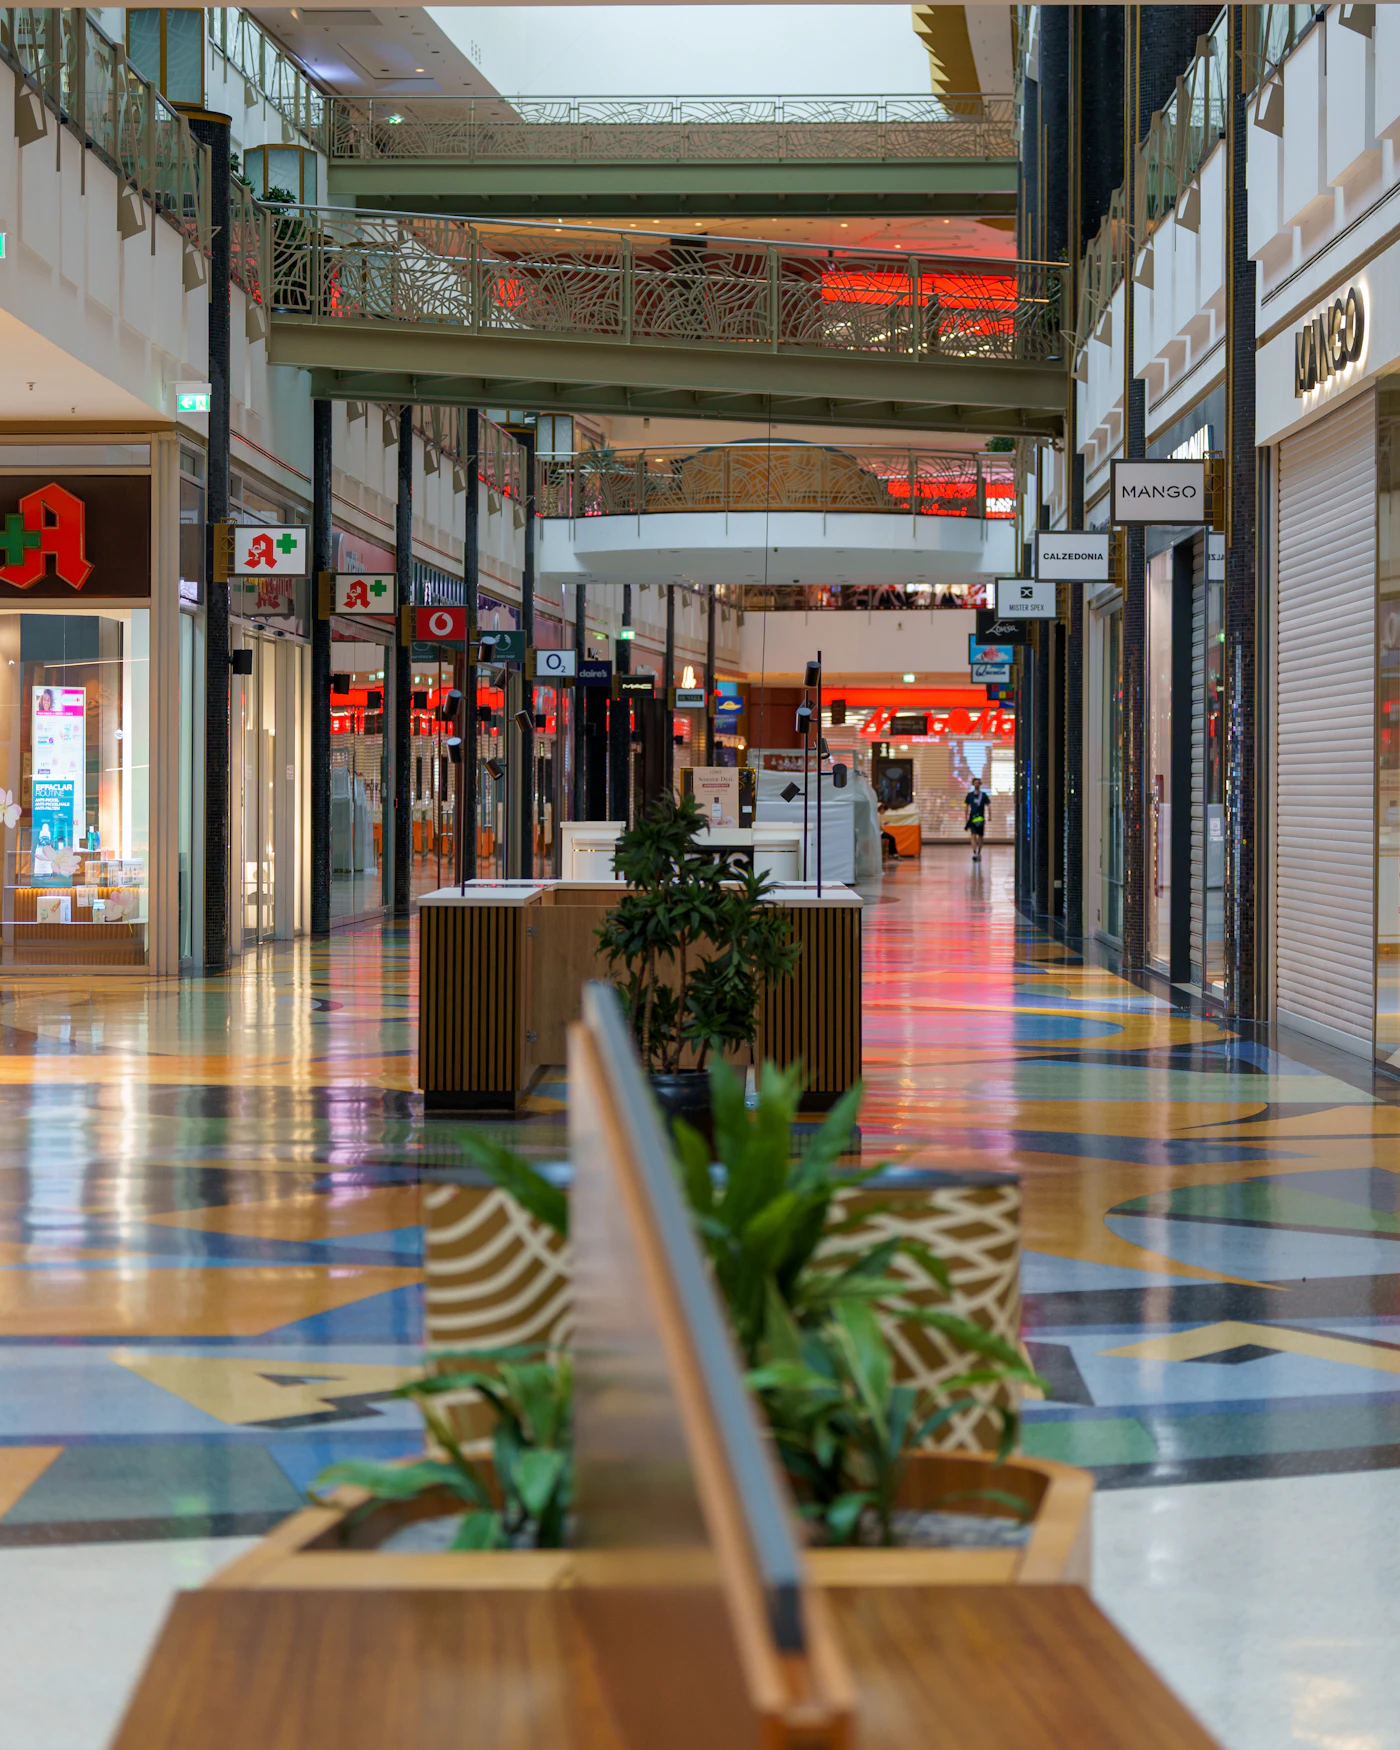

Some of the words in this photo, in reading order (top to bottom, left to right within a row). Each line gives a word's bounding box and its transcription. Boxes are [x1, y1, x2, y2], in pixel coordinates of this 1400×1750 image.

[1294, 286, 1364, 398] MANGO
[1122, 485, 1197, 498] MANGO
[1043, 552, 1104, 561] CALZEDONIA
[1009, 604, 1029, 612] MISTER
[1030, 604, 1045, 612] SPEX
[579, 669, 608, 678] claire's
